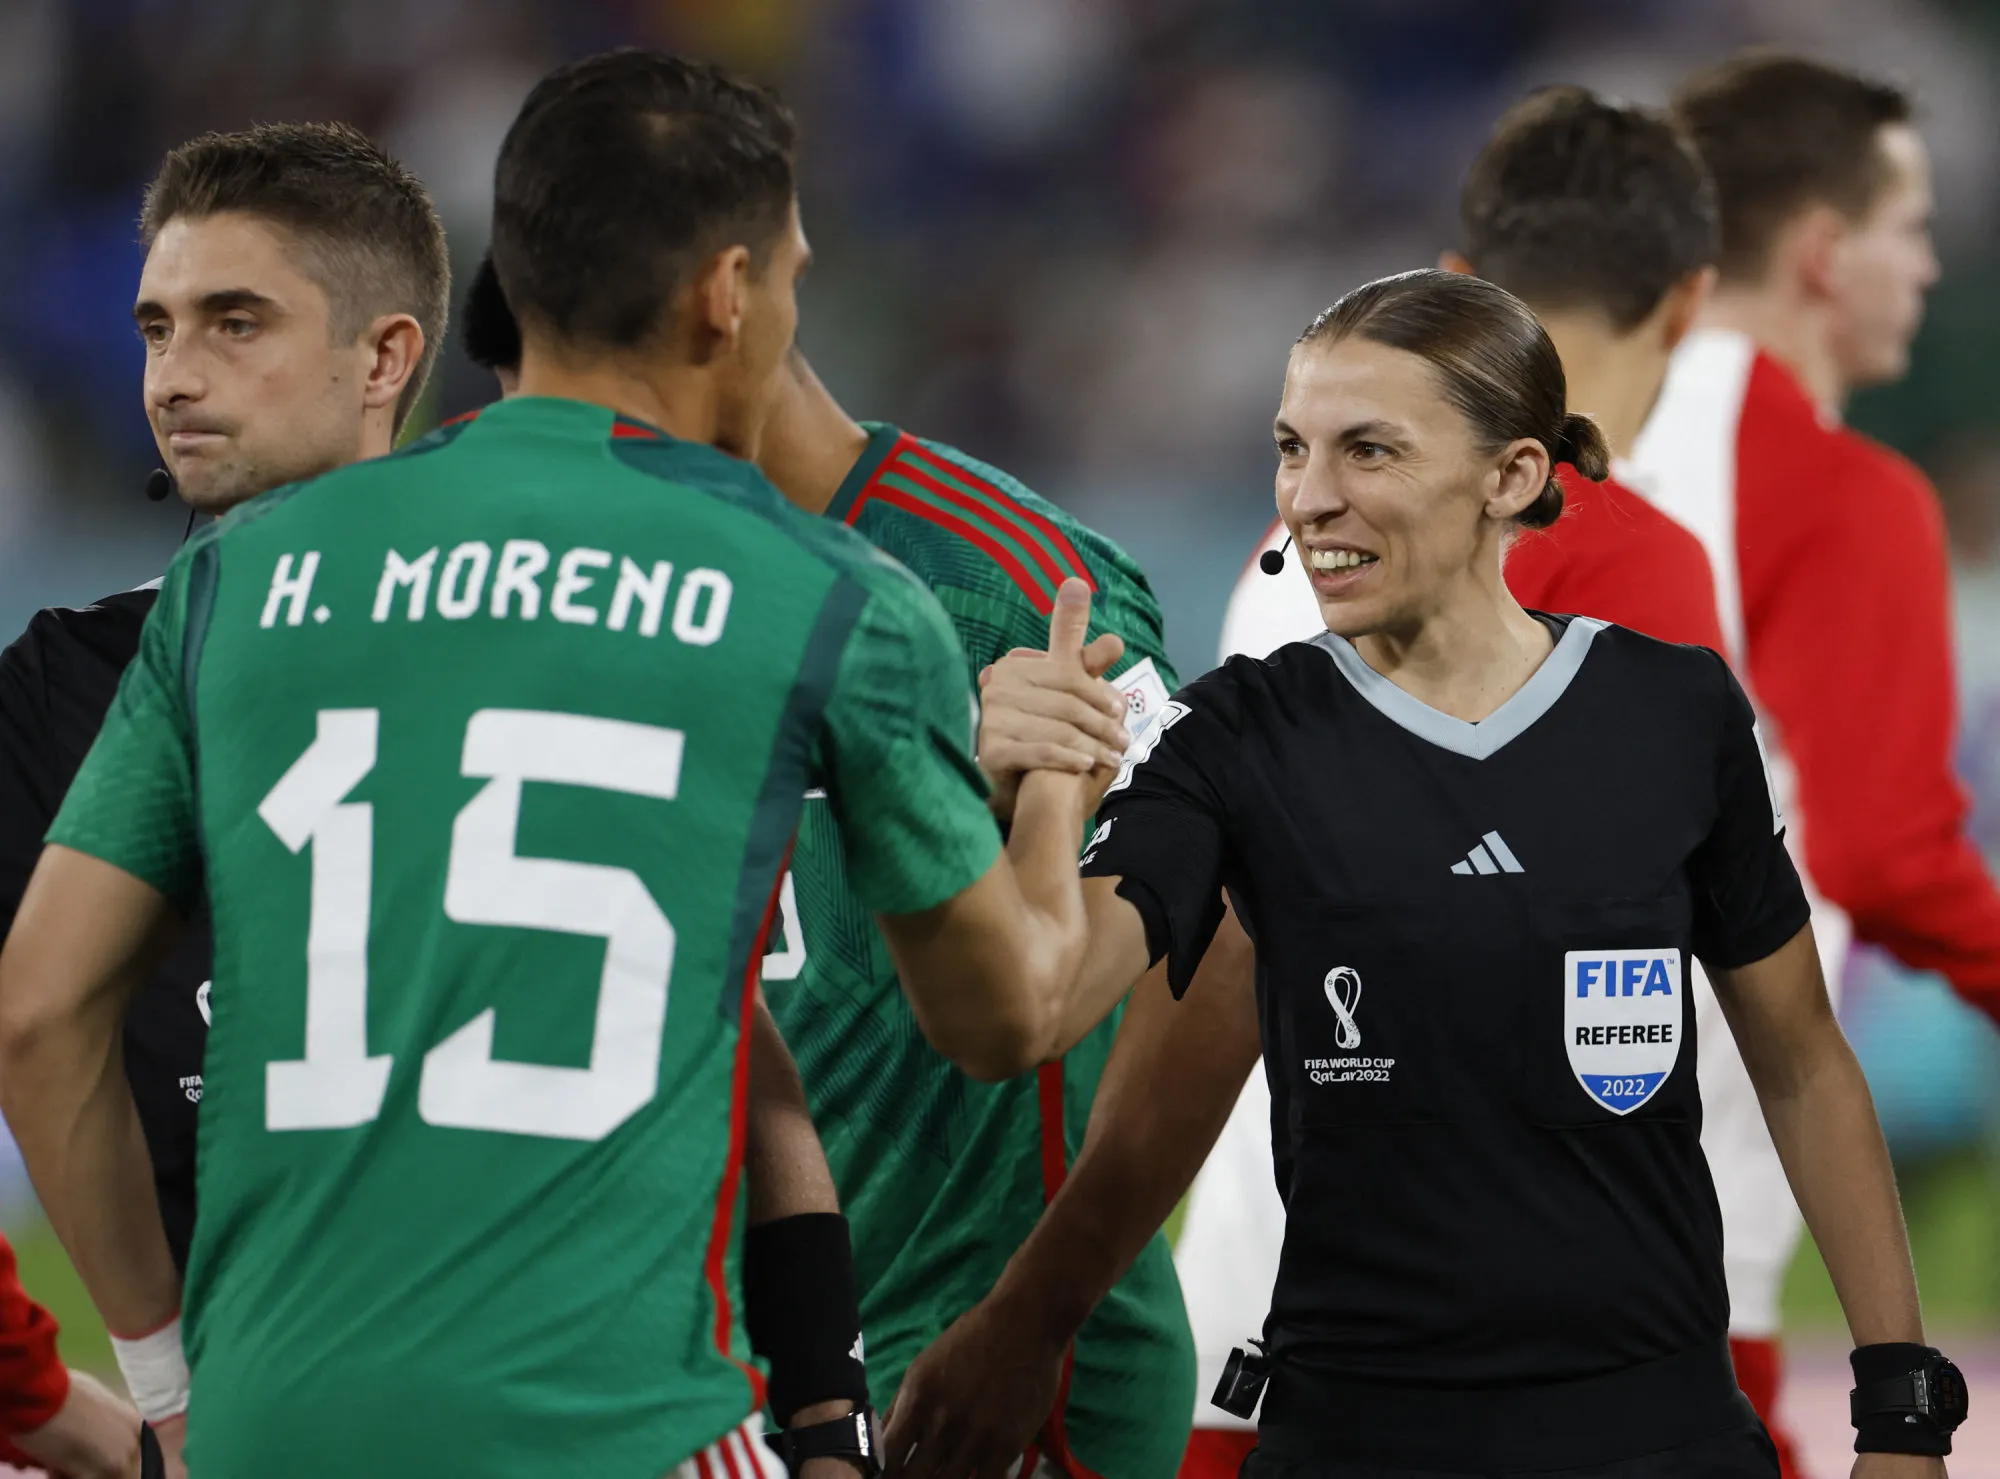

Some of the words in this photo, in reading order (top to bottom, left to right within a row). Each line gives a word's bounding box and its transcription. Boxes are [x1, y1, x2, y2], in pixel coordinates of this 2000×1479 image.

[260, 552, 330, 628] H.
[372, 540, 732, 645] MORENO
[258, 709, 684, 1140] 15
[1576, 1024, 1672, 1045] REFEREE
[1304, 1059, 1329, 1069] FIFA
[1330, 1058, 1371, 1068] WORLD
[1374, 1059, 1394, 1068] CUP
[1601, 1078, 1645, 1097] 2022
